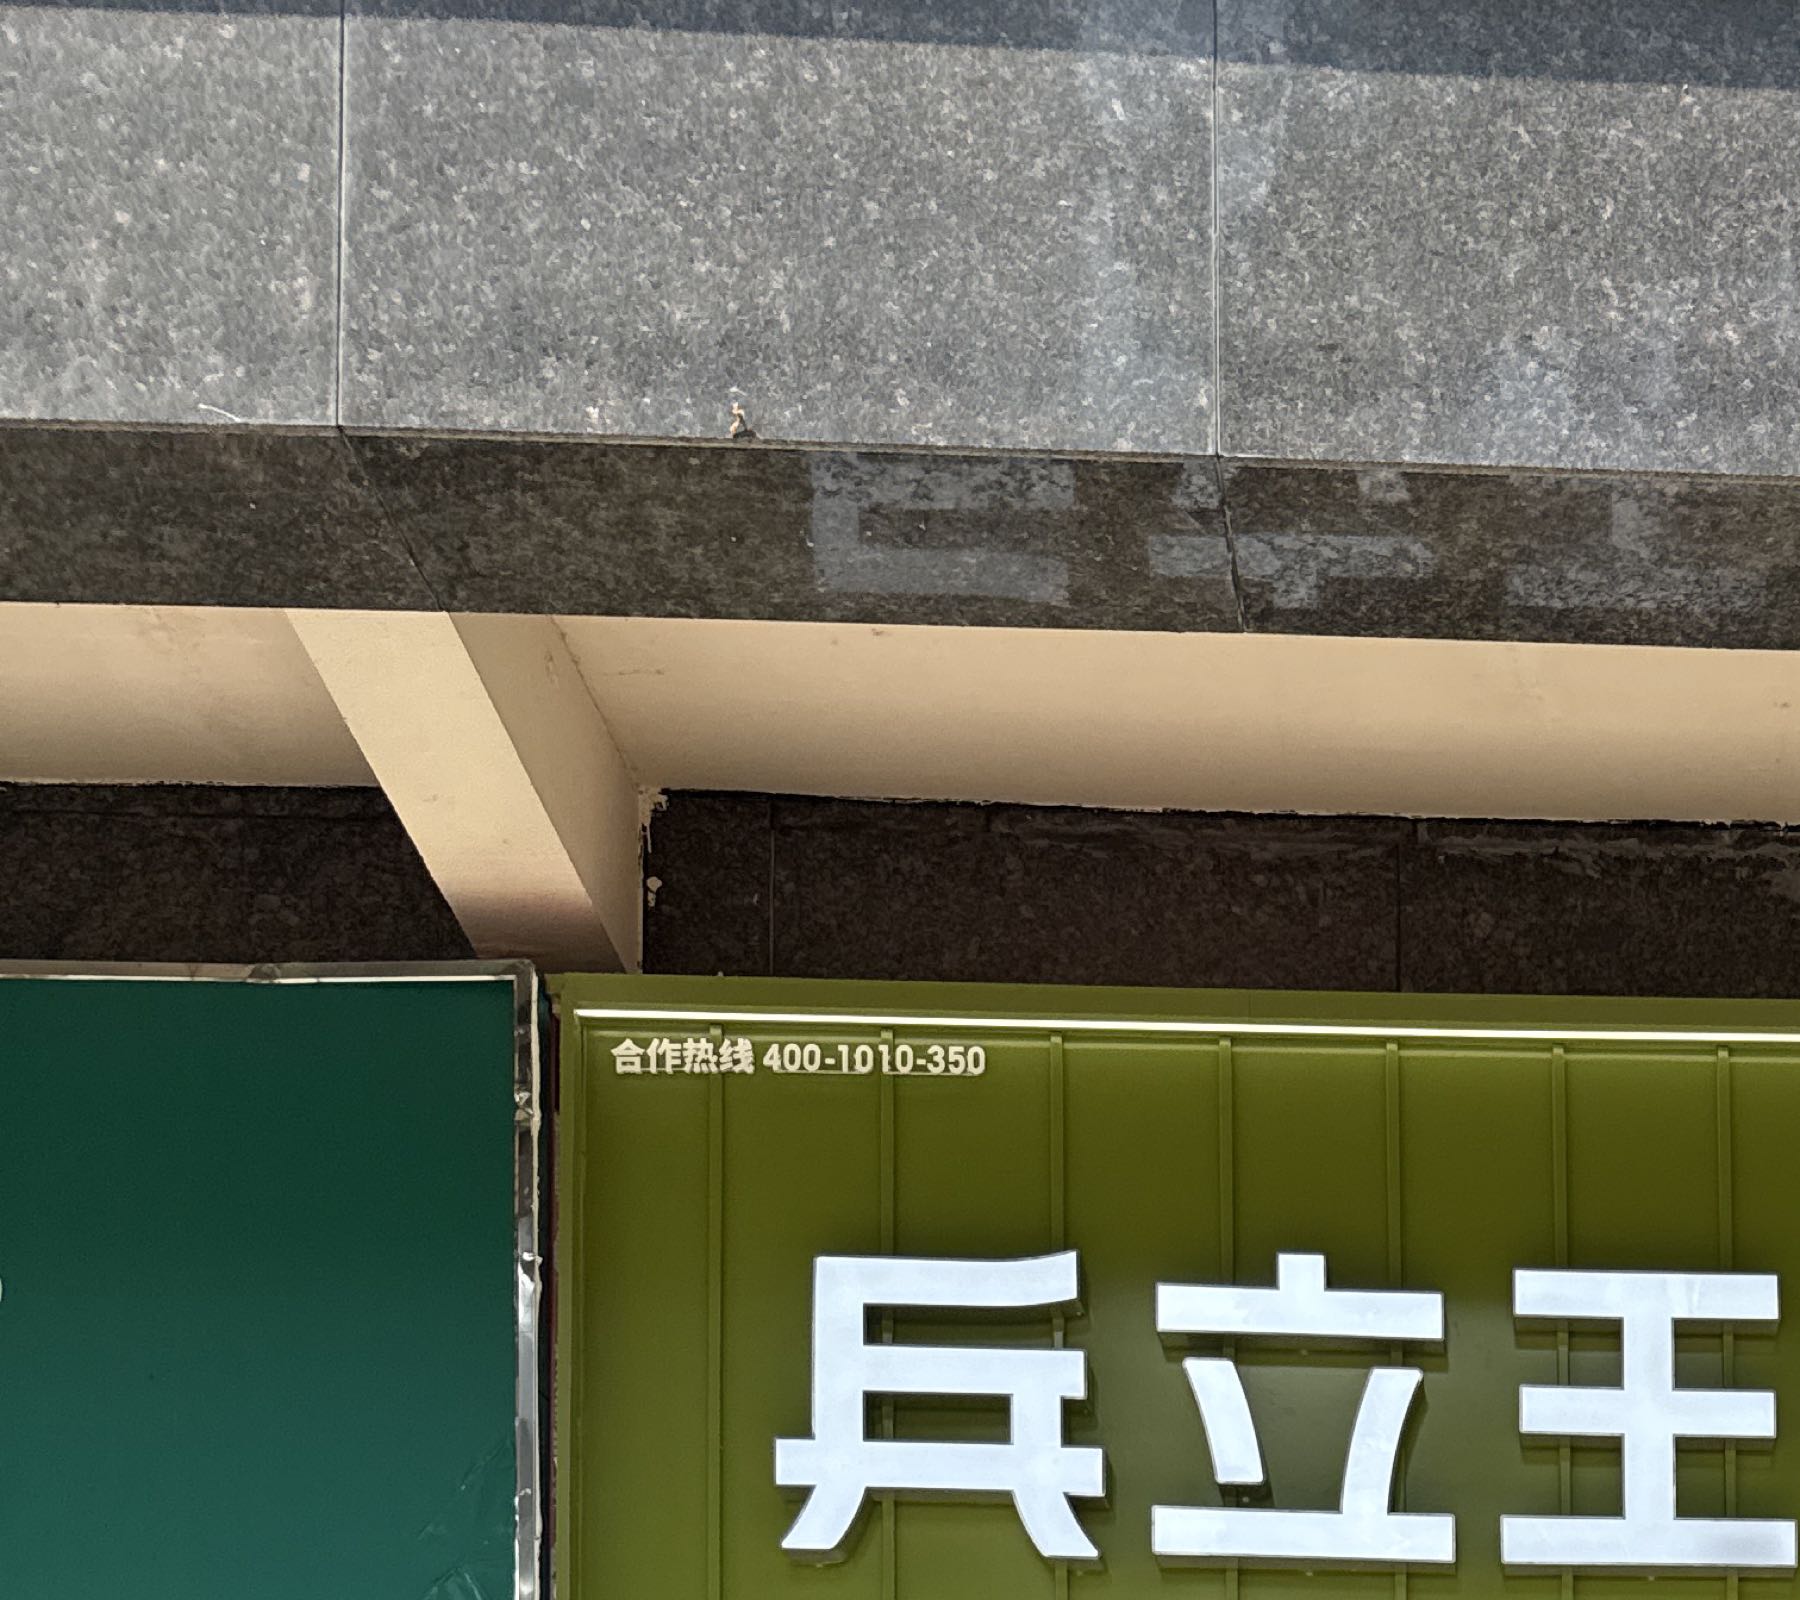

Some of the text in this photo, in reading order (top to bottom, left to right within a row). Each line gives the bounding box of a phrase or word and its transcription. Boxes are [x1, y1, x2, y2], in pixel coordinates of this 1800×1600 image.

[611, 1037, 986, 1075] 合作热线 400-1010-350
[775, 1250, 1798, 1567] 兵立王
